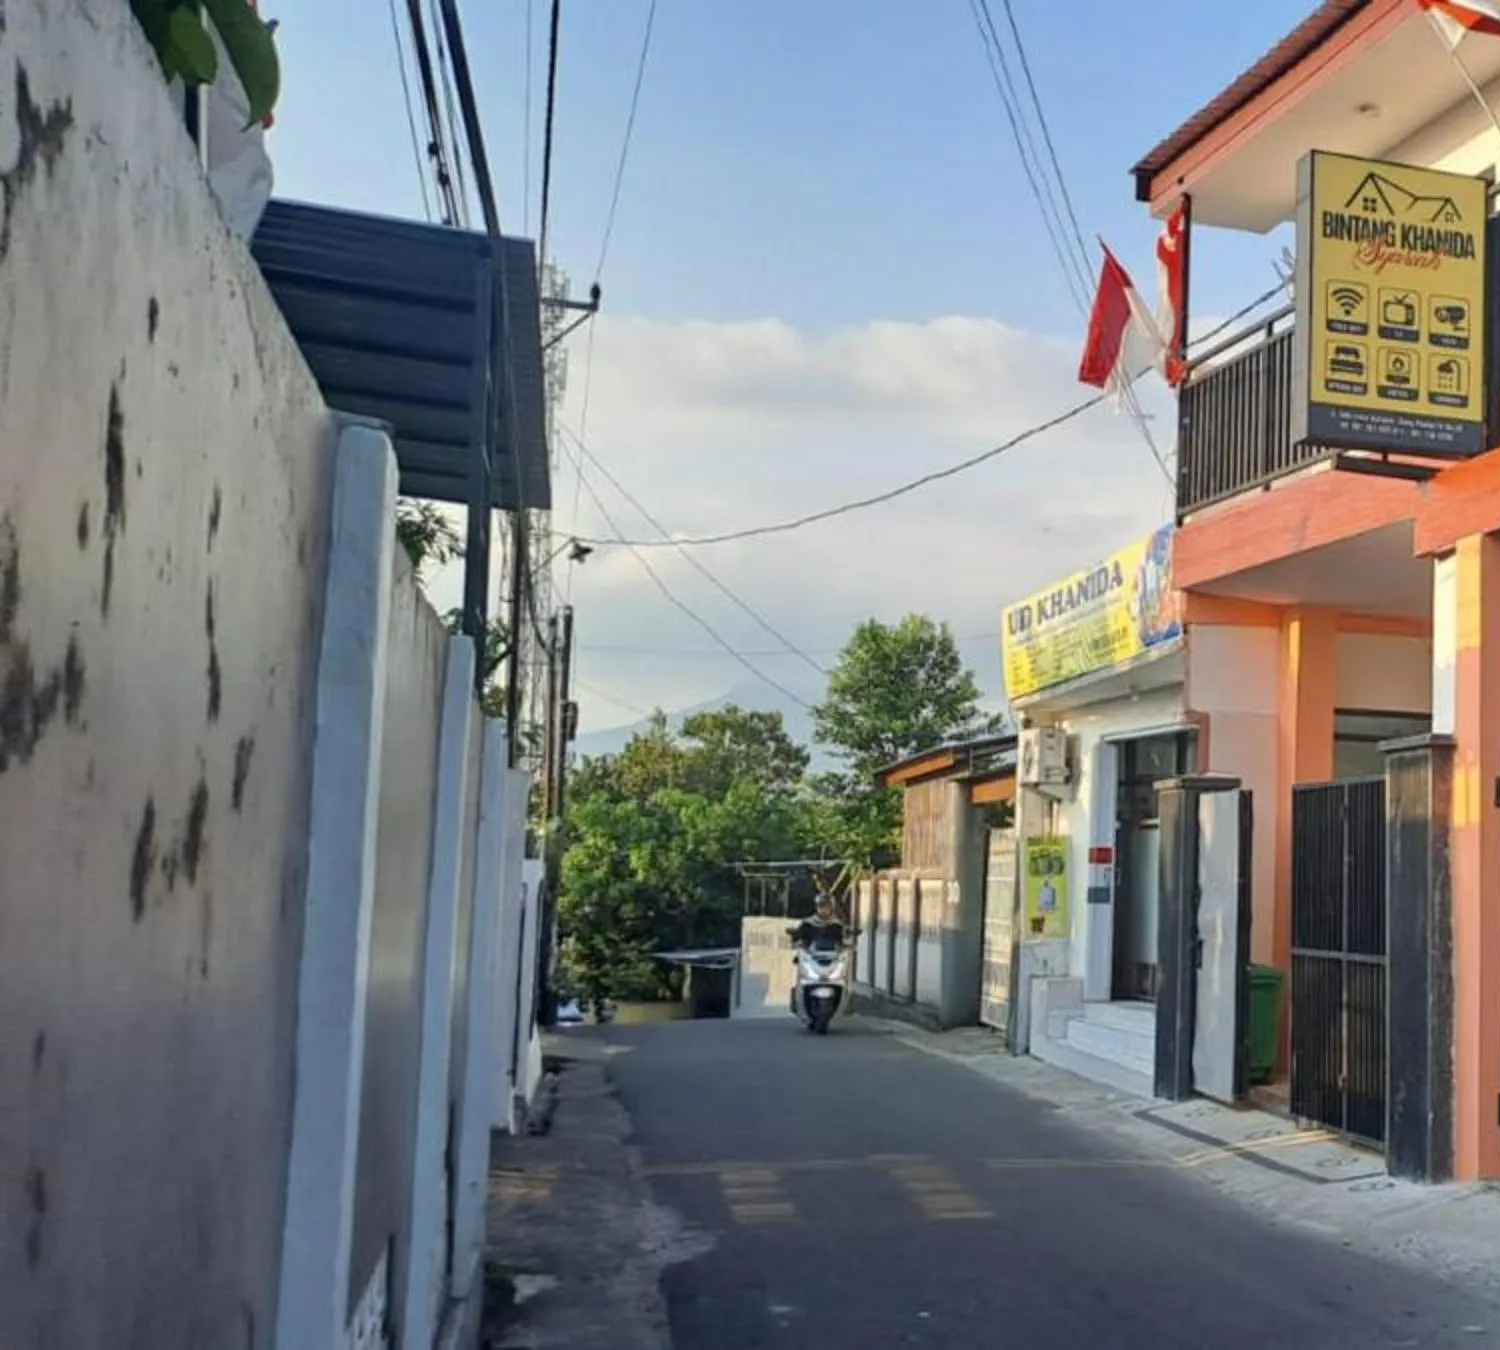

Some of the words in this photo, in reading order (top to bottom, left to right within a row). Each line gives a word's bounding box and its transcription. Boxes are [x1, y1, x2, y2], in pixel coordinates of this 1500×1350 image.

[1322, 210, 1397, 248] BINTANG
[1400, 223, 1476, 260] KHANIDA
[1008, 604, 1032, 636] UD
[1037, 560, 1124, 625] KHANIDA
